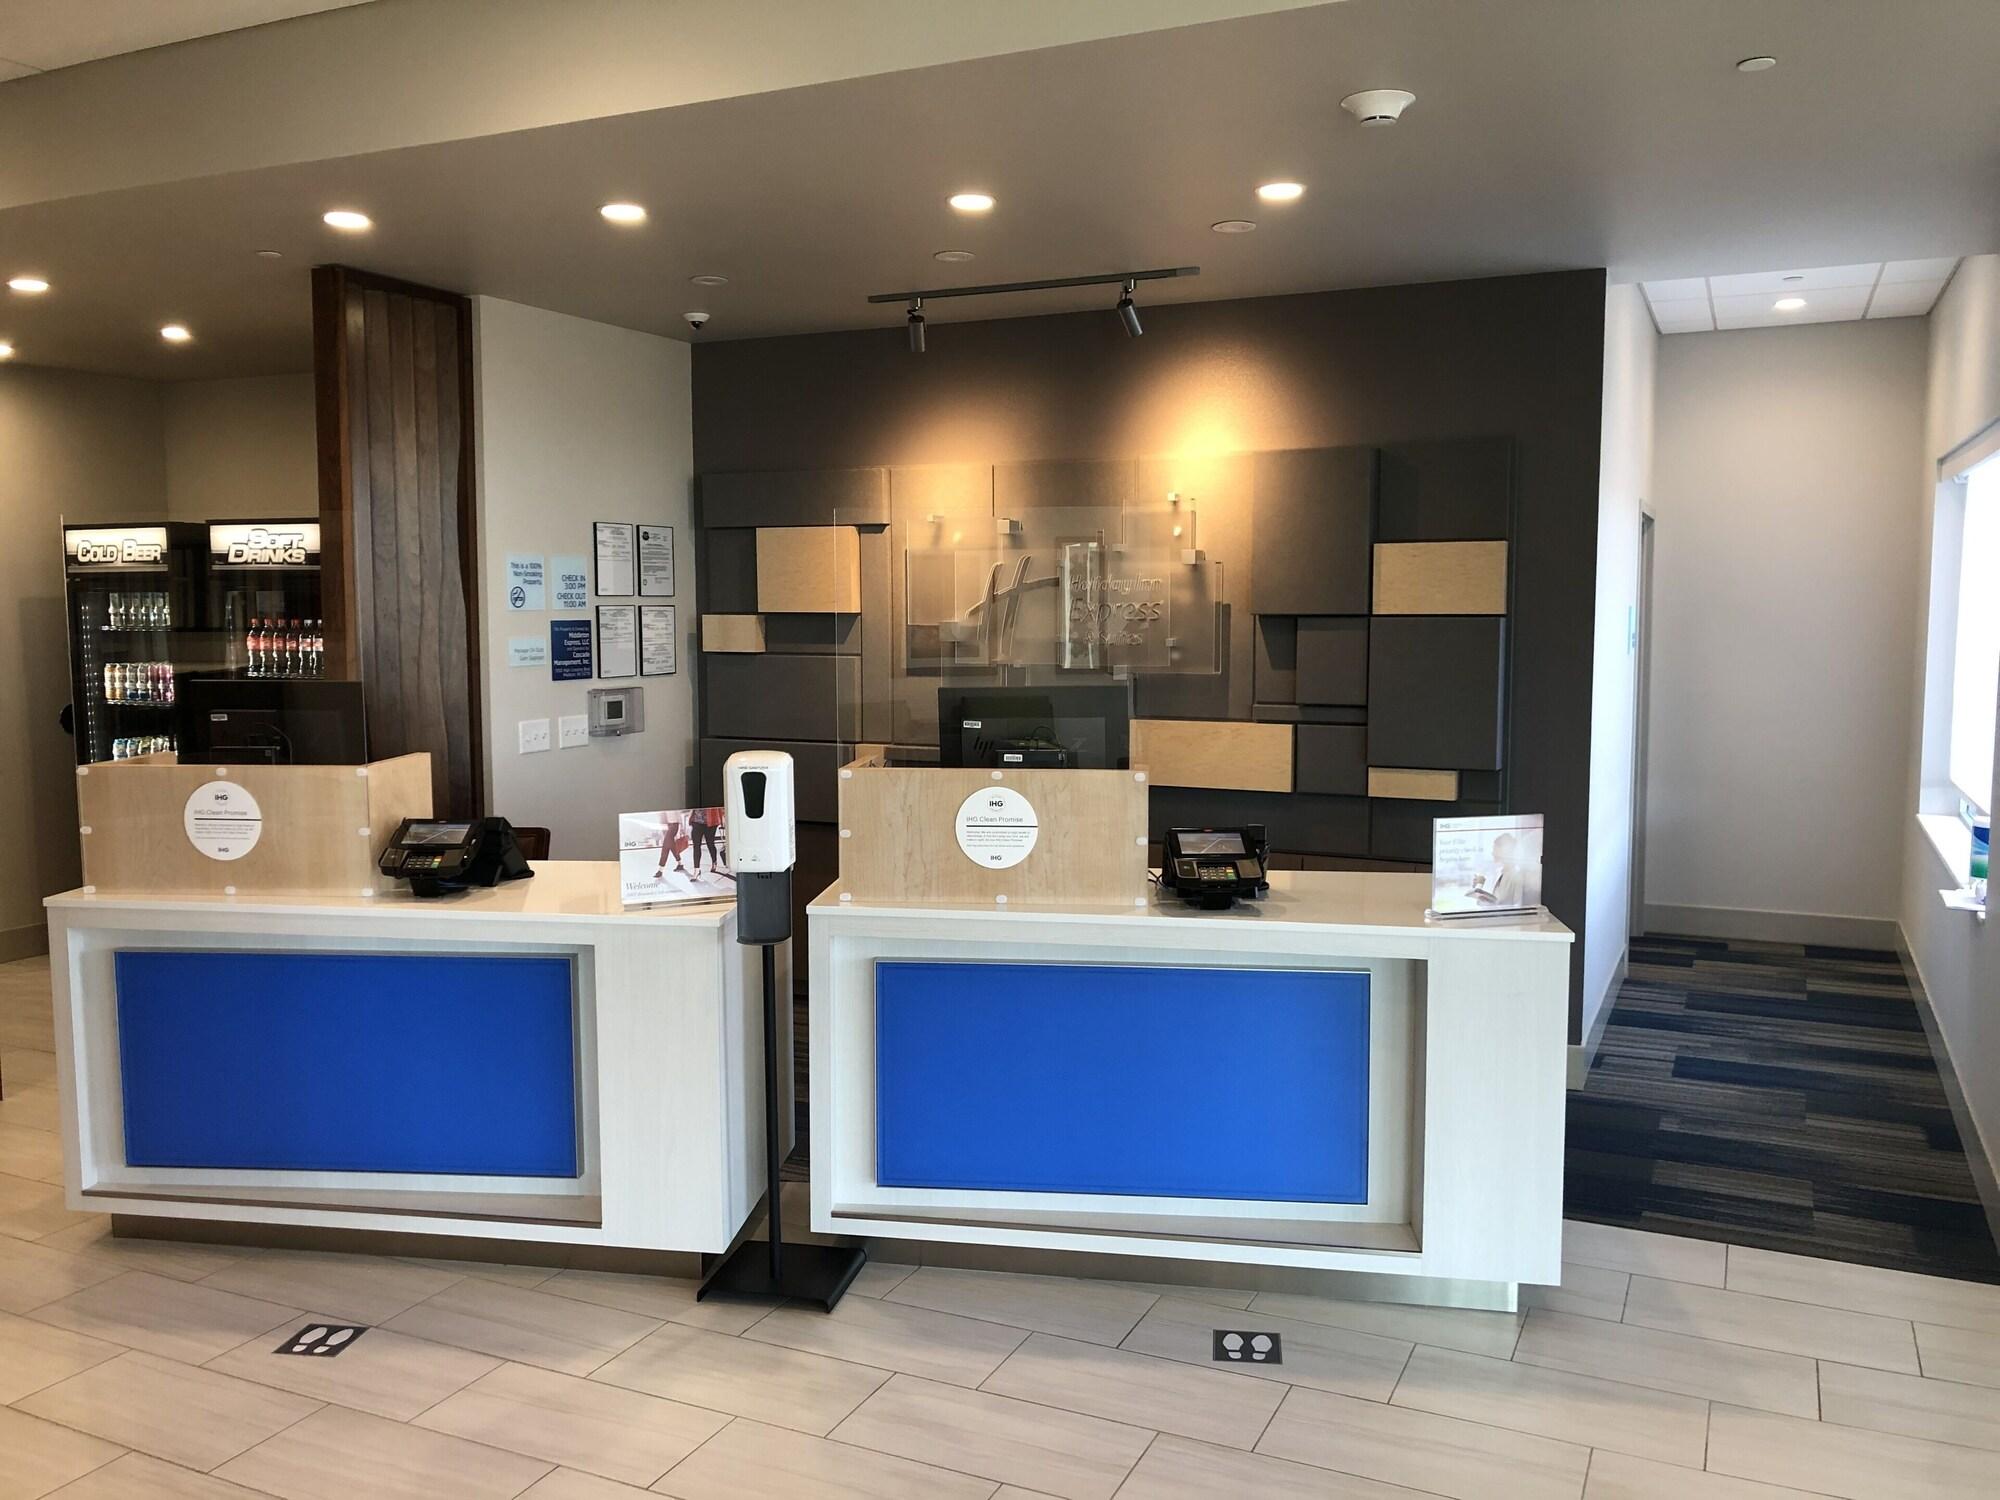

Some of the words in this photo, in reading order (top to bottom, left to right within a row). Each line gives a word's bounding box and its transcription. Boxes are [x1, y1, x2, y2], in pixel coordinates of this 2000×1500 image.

[77, 540, 119, 562] COLD
[122, 539, 162, 562] BEER
[227, 542, 307, 564] DRINKS
[561, 574, 579, 582] CHECK
[564, 582, 576, 590] 3:00
[557, 592, 574, 600] CHECK
[575, 592, 586, 600] OUT
[578, 600, 586, 608] AM
[1070, 597, 1163, 627] Express
